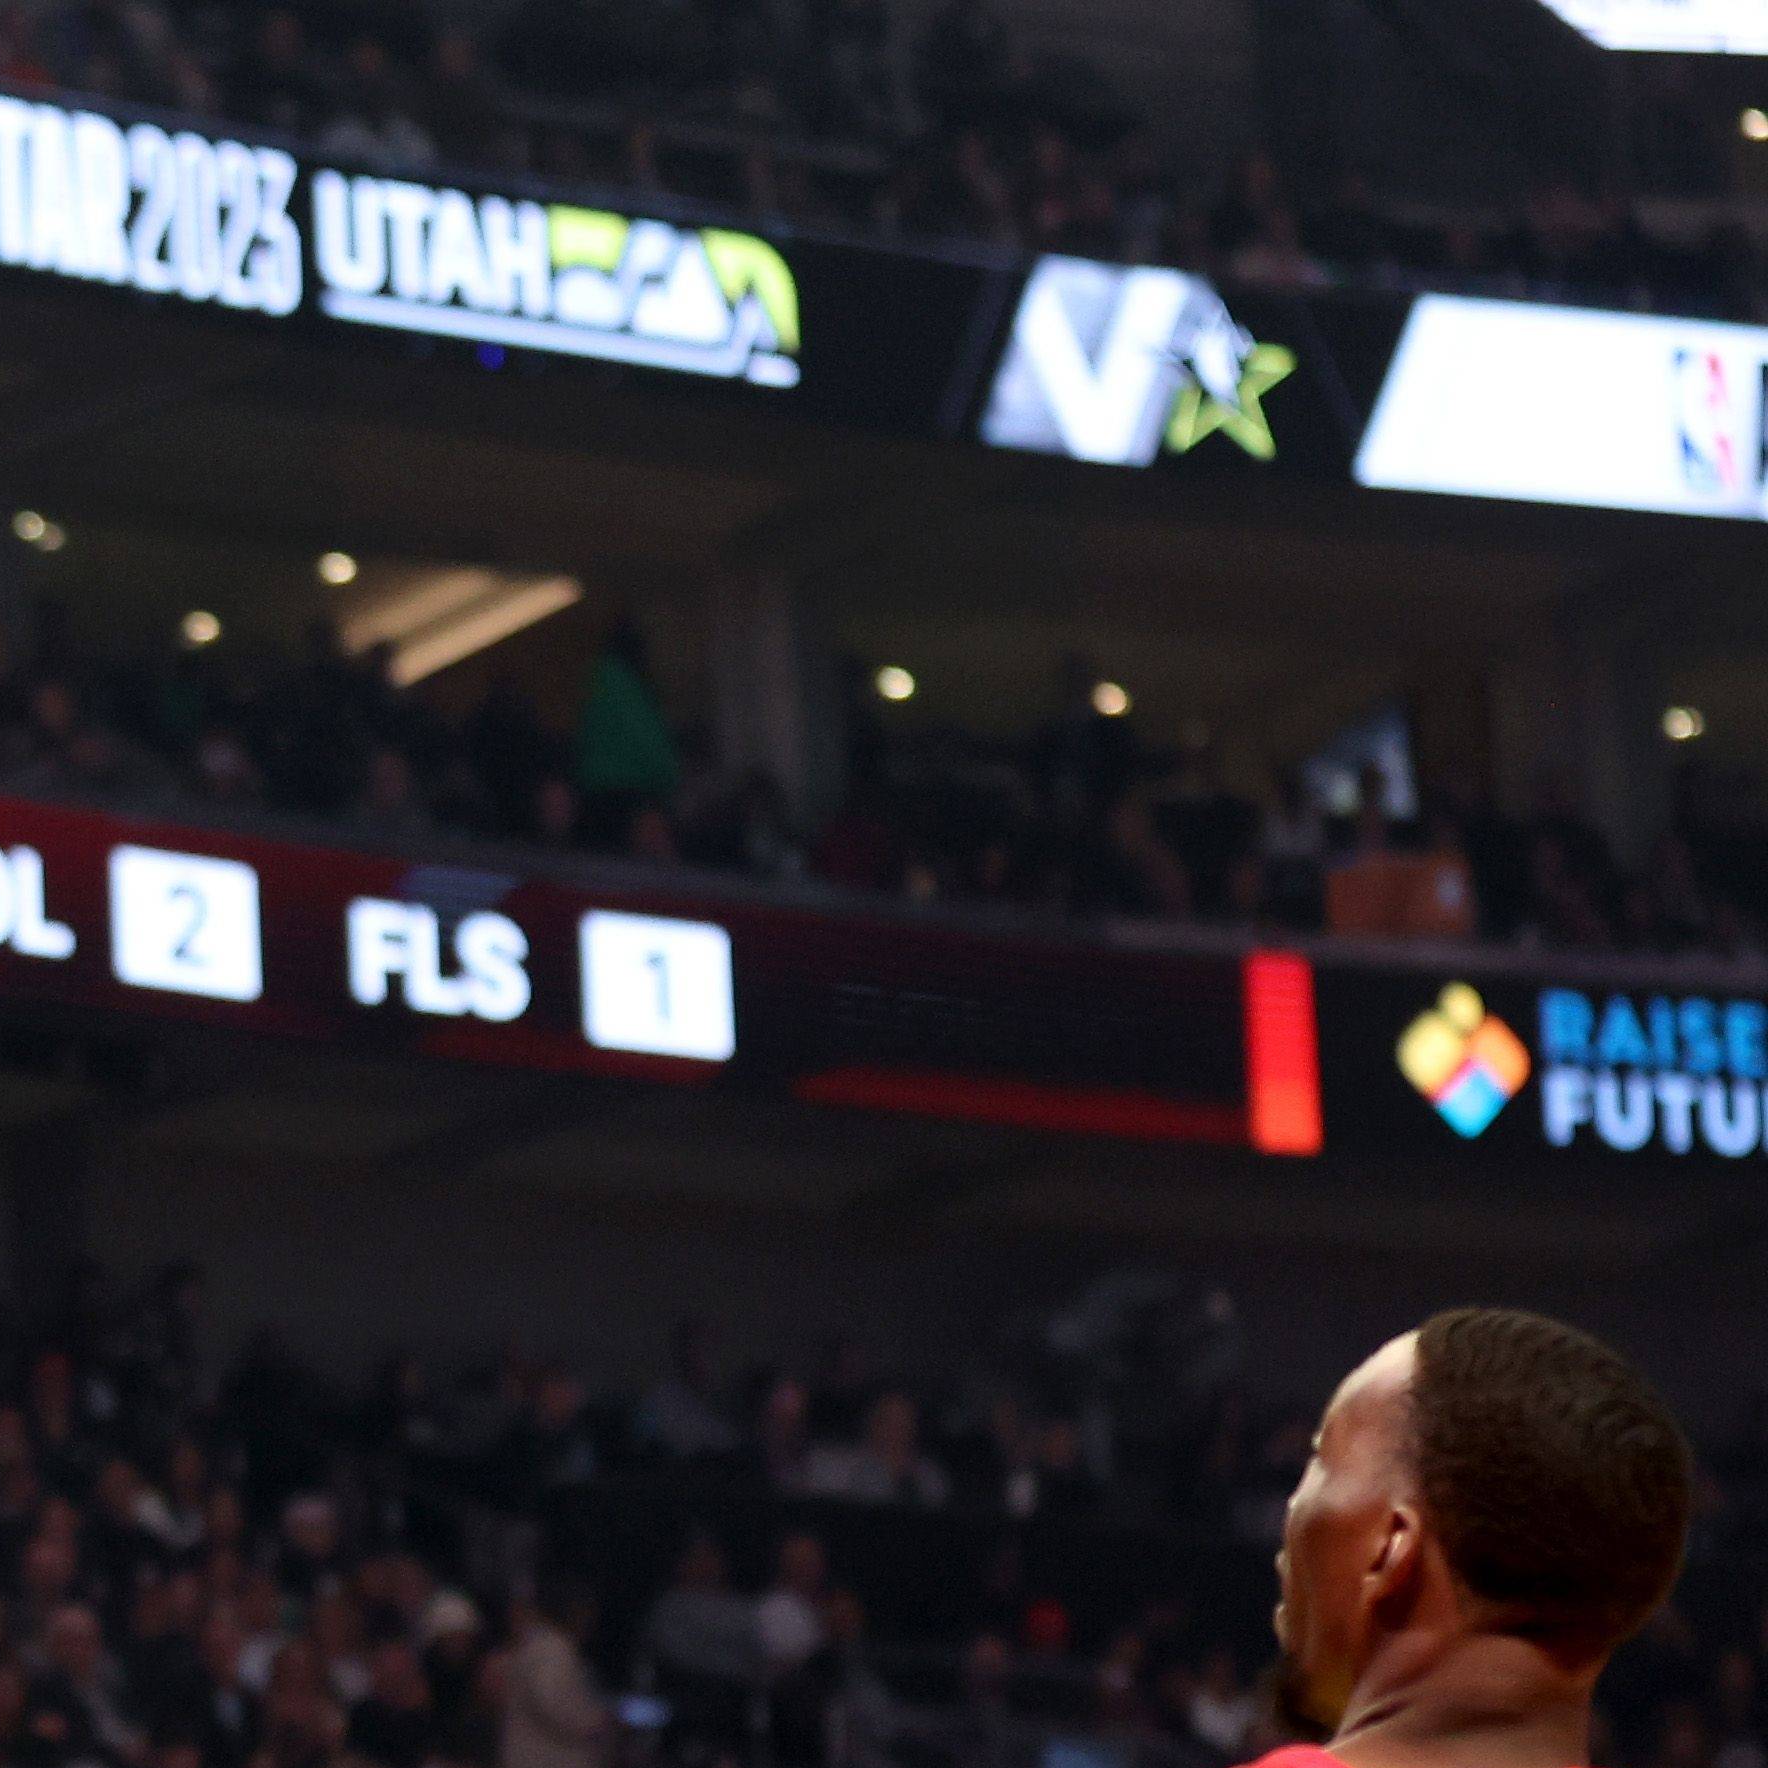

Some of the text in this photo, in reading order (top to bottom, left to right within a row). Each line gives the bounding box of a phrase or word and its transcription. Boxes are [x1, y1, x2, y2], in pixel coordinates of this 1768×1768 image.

[312, 168, 552, 322] UTAH
[167, 883, 213, 970] 2
[345, 896, 532, 1023] FLS
[642, 948, 672, 1022] 1
[1543, 1066, 1768, 1159] FUTU
